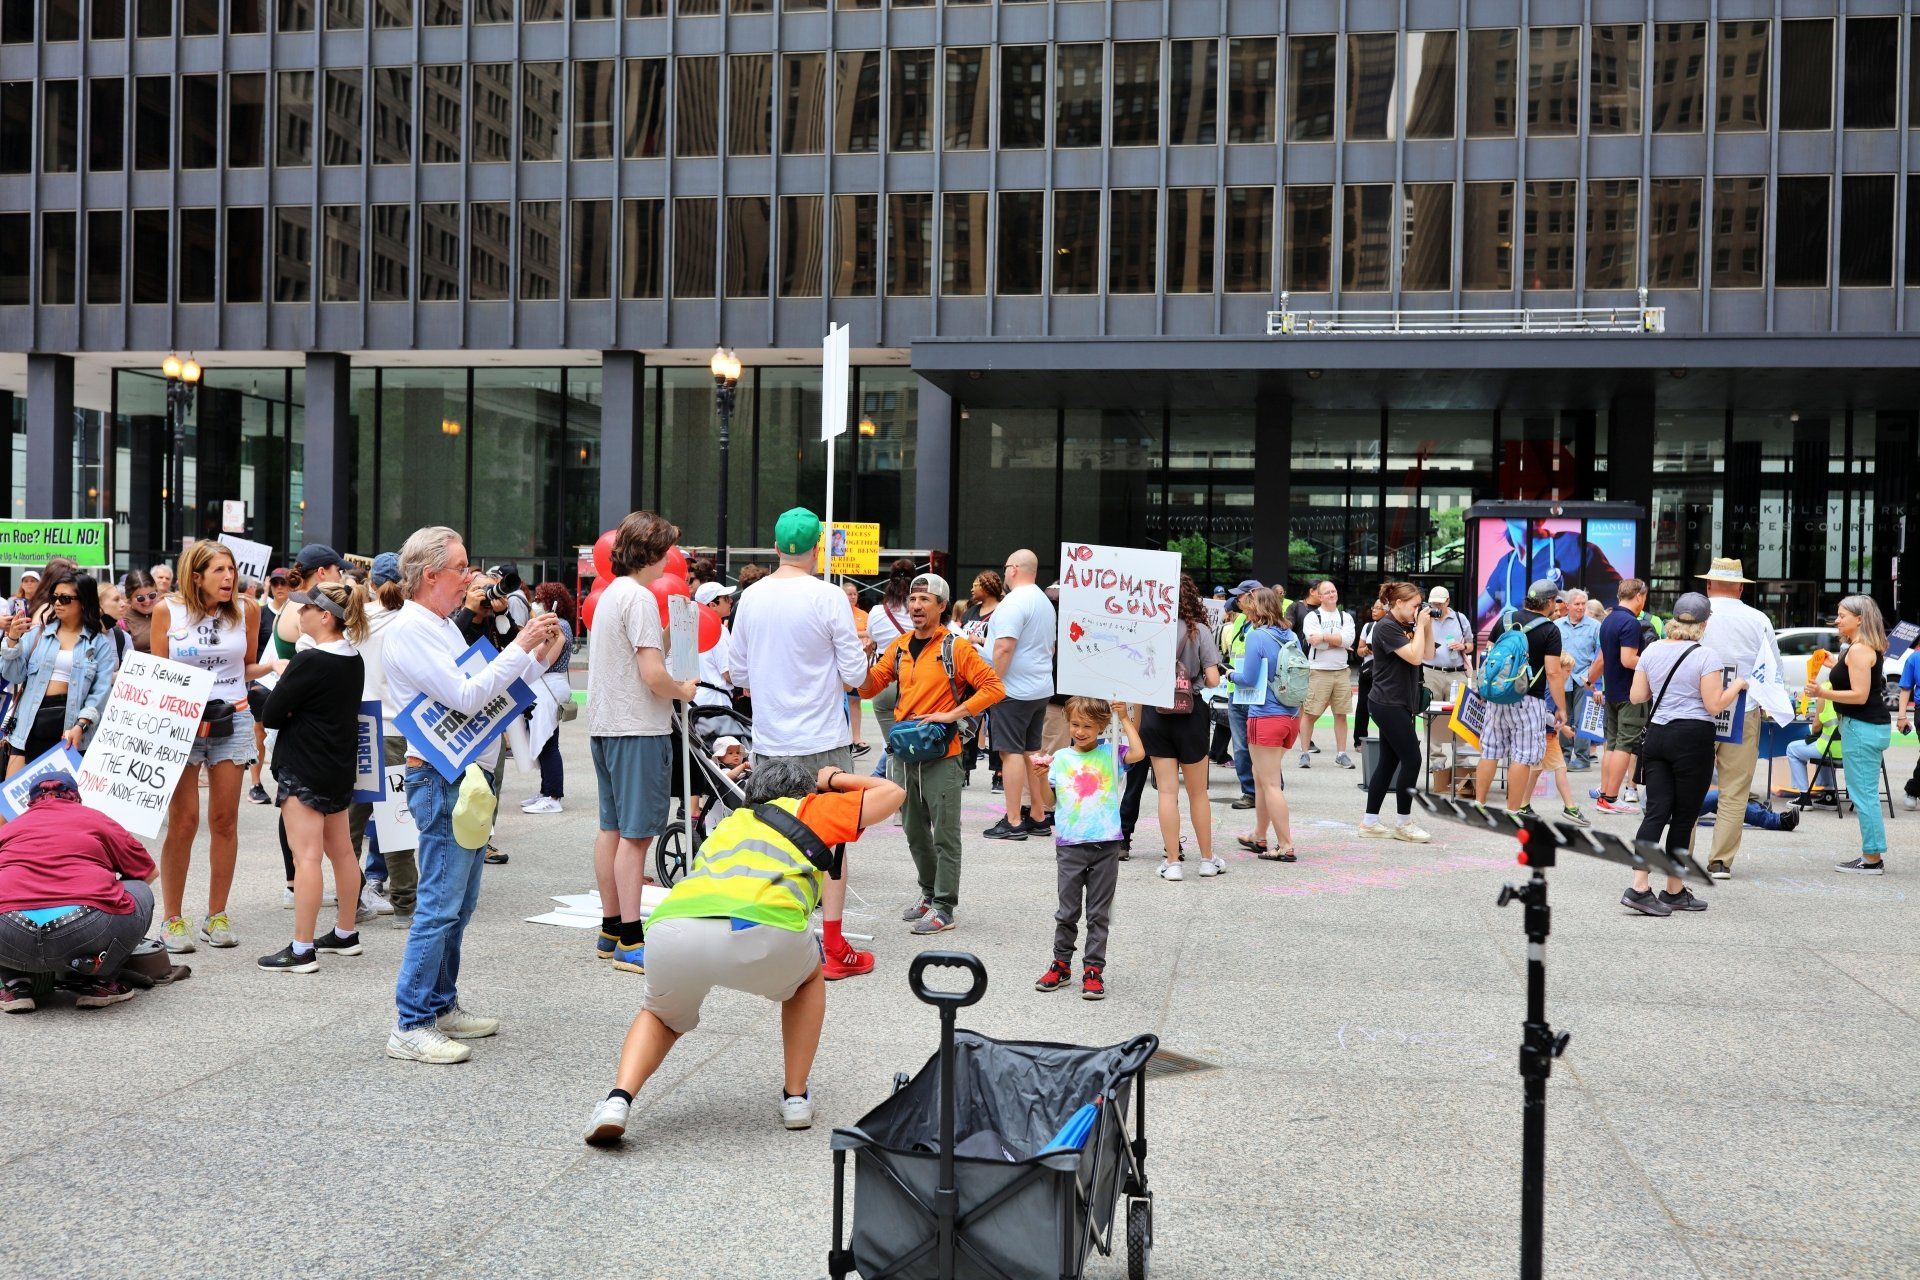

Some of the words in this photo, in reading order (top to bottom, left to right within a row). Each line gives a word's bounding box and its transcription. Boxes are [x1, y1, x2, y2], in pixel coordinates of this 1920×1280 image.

[13, 530, 40, 544] Roe?
[43, 528, 72, 544] HELL
[76, 529, 99, 545] NO!
[1714, 521, 1791, 531] STATES
[1066, 546, 1094, 561] NO
[1693, 543, 1747, 551] SOUTH
[1064, 564, 1175, 605] AUTOMATIC
[152, 663, 191, 686] RENAME
[113, 681, 152, 705] SCHOOLS
[159, 694, 201, 719] UTERUS
[1469, 697, 1487, 716] MARC
[1586, 700, 1594, 721] LIVES
[107, 705, 119, 722] SO
[121, 710, 136, 727] THE
[137, 713, 172, 735] GOP
[169, 726, 192, 743] WILL
[446, 709, 491, 756] LIVES
[98, 728, 124, 748] START
[122, 735, 154, 756] CARING
[154, 745, 189, 767] ABOUT
[357, 721, 373, 775] MARCH
[77, 770, 109, 793] DYING
[107, 782, 139, 802] INSIDE
[99, 752, 126, 774] THE
[126, 758, 166, 789] KIDS
